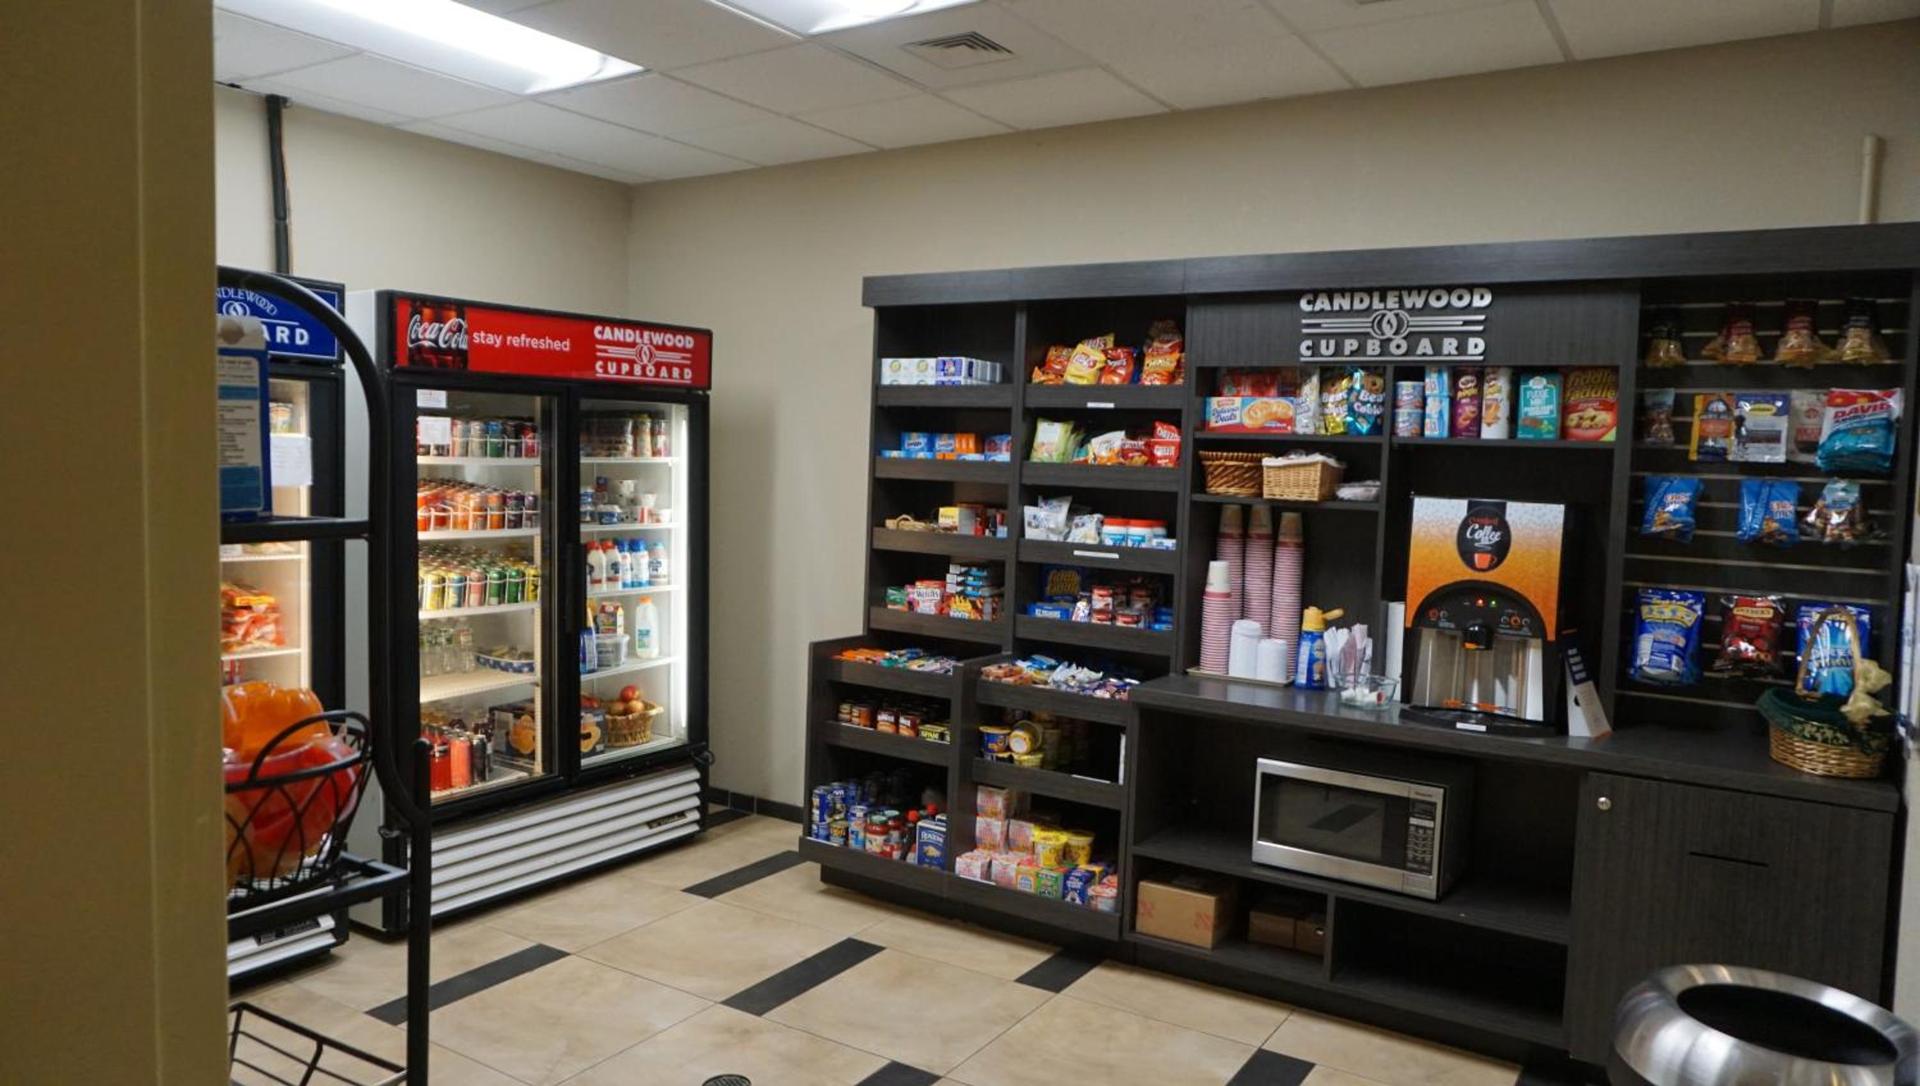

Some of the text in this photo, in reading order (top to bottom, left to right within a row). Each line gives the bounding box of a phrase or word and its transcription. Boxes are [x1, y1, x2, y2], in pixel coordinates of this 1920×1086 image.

[1300, 288, 1492, 312] CANDLEWOOD
[472, 330, 571, 352] stay refreshed
[593, 325, 694, 349] CANDLEWOOD
[1300, 337, 1486, 356] CUPBOARD
[595, 361, 692, 379] CUPBOARD
[1833, 402, 1892, 419] DAVID
[1466, 523, 1502, 545] Coffee
